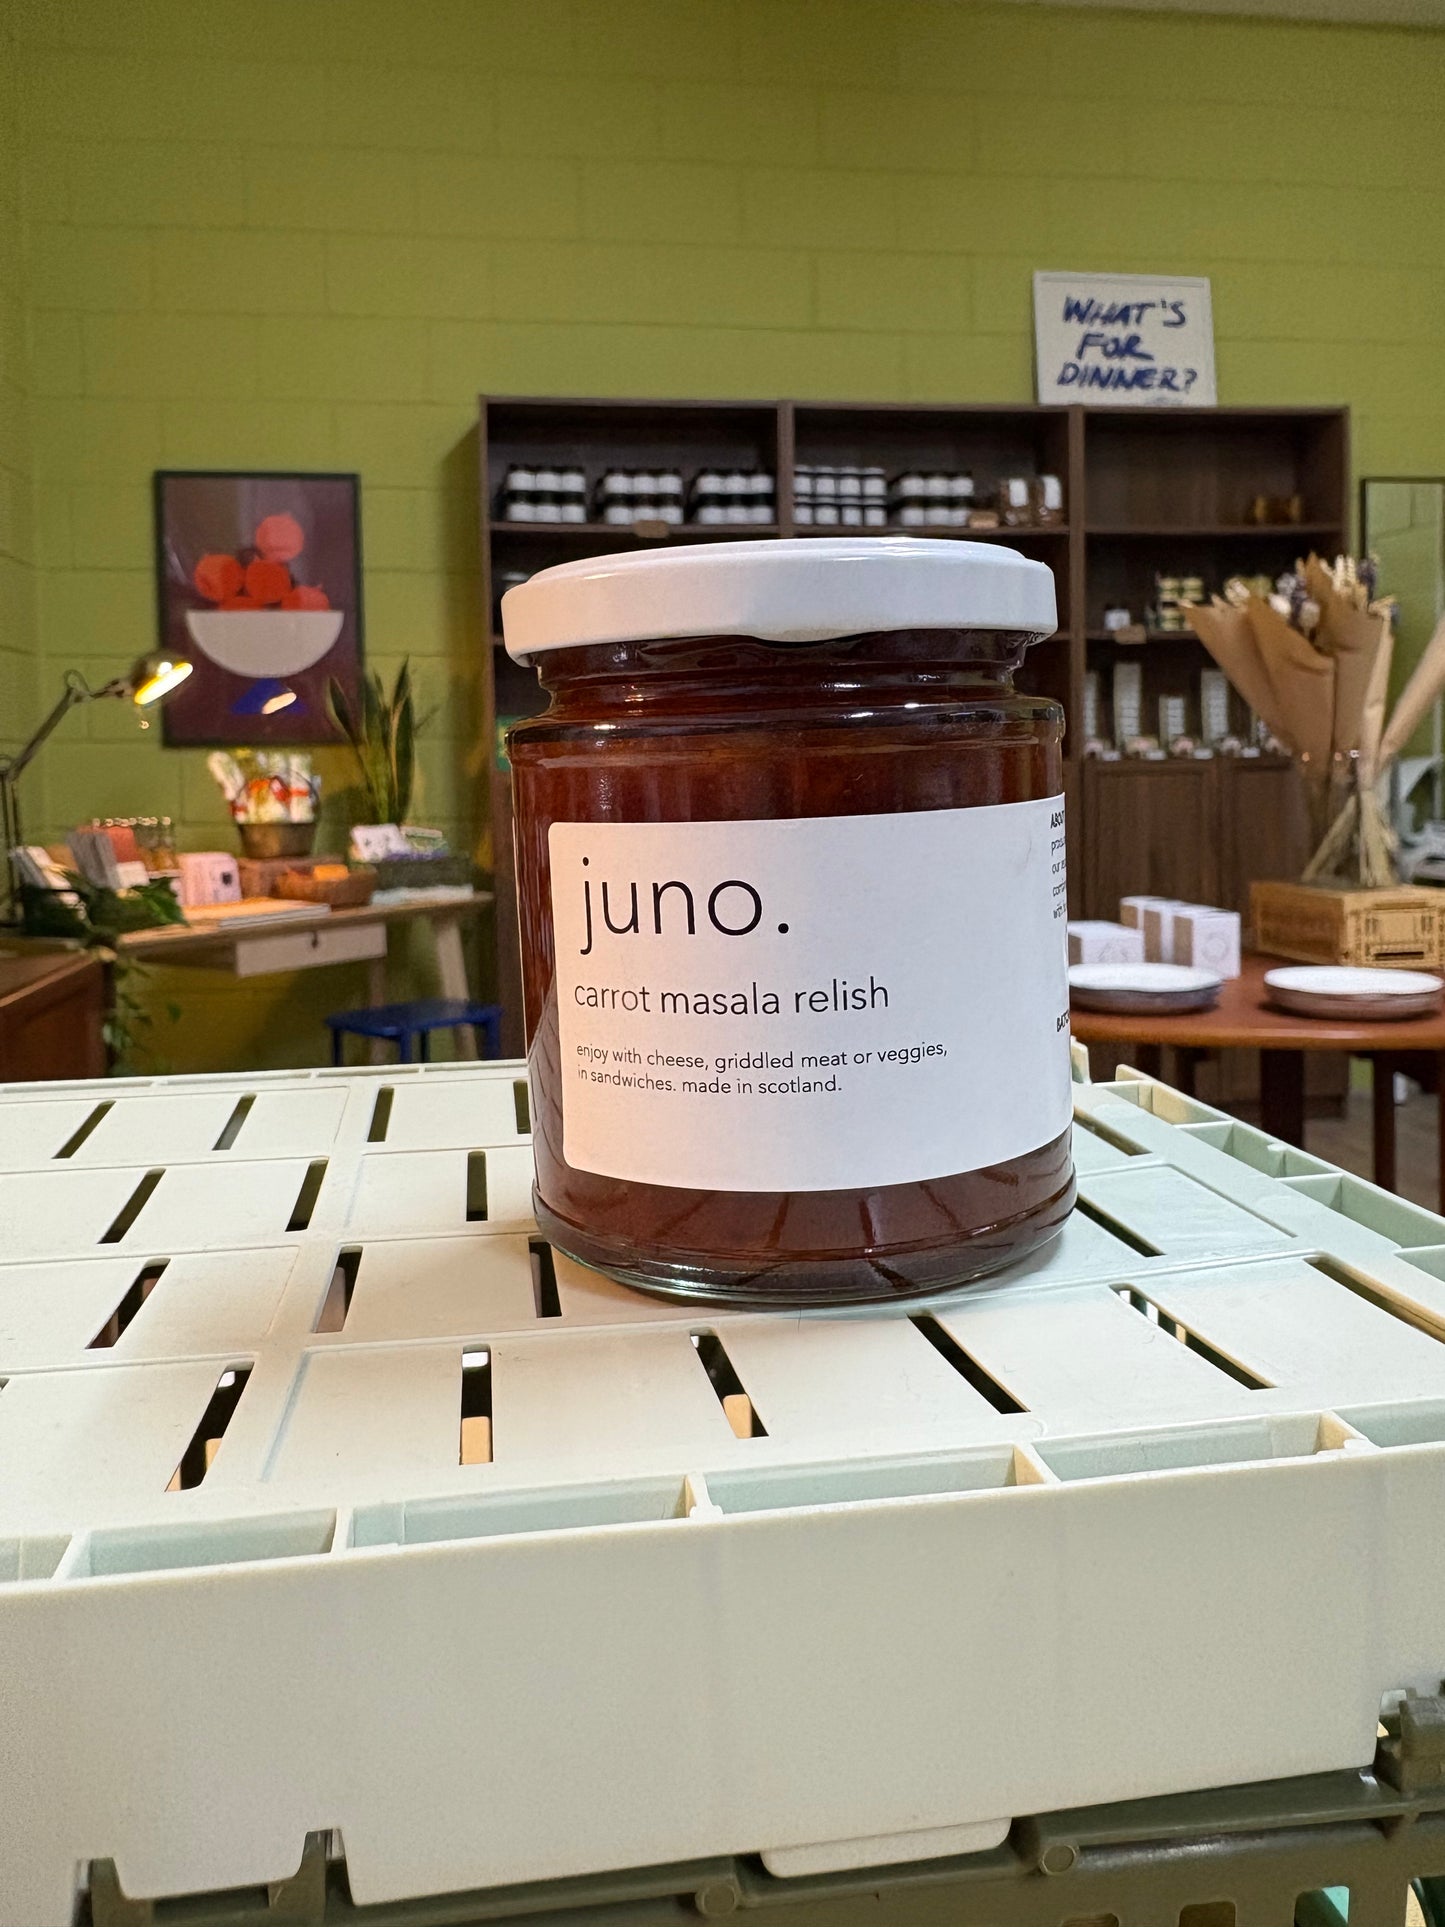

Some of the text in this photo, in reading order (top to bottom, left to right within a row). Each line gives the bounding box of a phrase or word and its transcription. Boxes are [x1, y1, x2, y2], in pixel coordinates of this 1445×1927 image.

[1062, 295, 1186, 328] WHAT'S
[1075, 332, 1154, 360] FOR
[1056, 361, 1198, 393] DINNER?
[579, 856, 790, 956] juno.
[574, 976, 889, 1015] carrot masala relish
[576, 1041, 948, 1074] enjoy with cheese, griddled meat or veggies,
[577, 1063, 843, 1094] in sandwiches. made in scotland.
